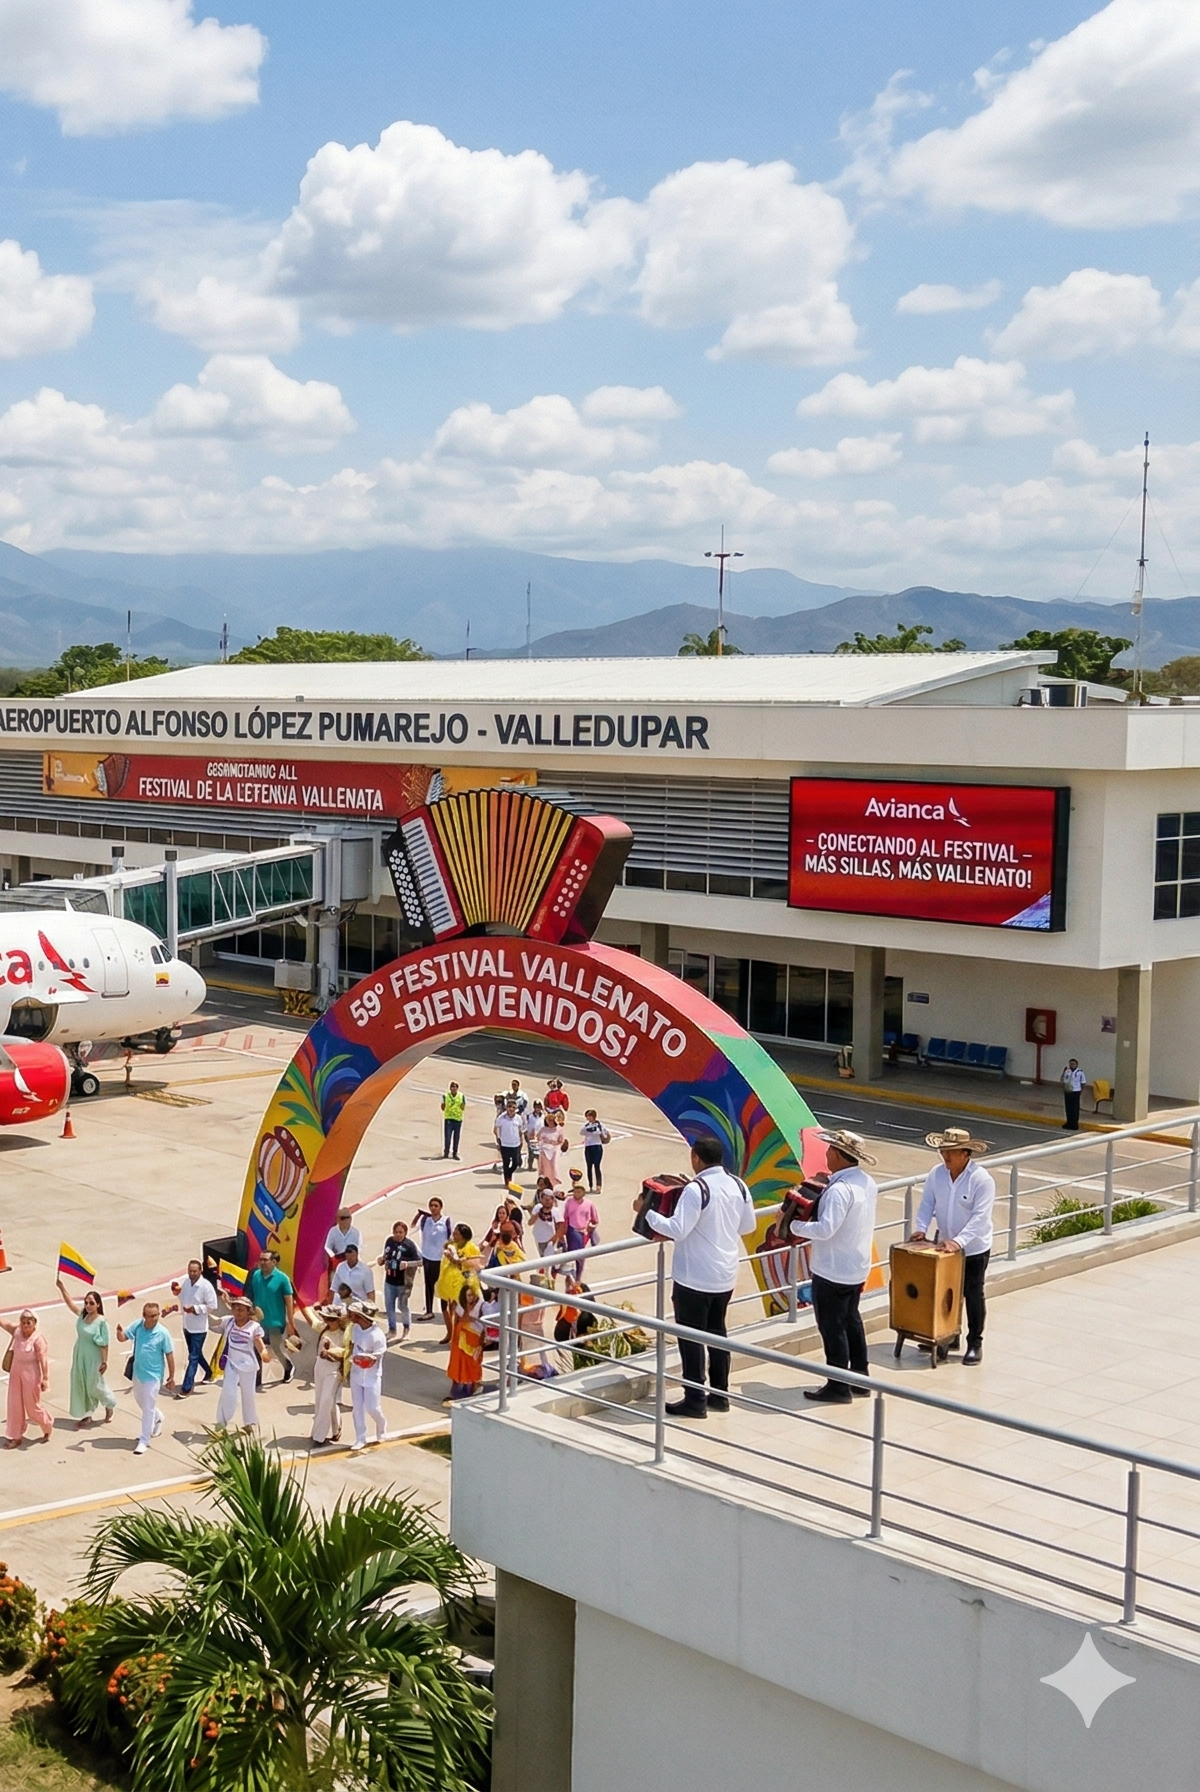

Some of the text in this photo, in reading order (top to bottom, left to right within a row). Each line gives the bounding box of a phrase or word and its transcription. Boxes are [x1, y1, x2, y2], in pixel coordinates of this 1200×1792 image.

[126, 710, 228, 737] ALFONSO
[235, 706, 312, 739] LÓPEZ
[319, 712, 468, 743] PUMAREJO
[494, 714, 710, 749] VALLEDUPAR
[139, 777, 193, 799] FESTIVAL
[197, 780, 212, 799] DE
[217, 781, 233, 801] LA
[302, 785, 383, 810] VALLENATA
[865, 797, 944, 820] Avianca
[818, 833, 916, 856] CONECTANDO
[920, 839, 939, 858] AL
[944, 840, 1019, 863] FESTIVAL
[805, 851, 1032, 889] MÁS SILLAS, MÁS VALLENATO!
[390, 949, 513, 999] FESTIVAL
[520, 951, 687, 1058] VALLENATO
